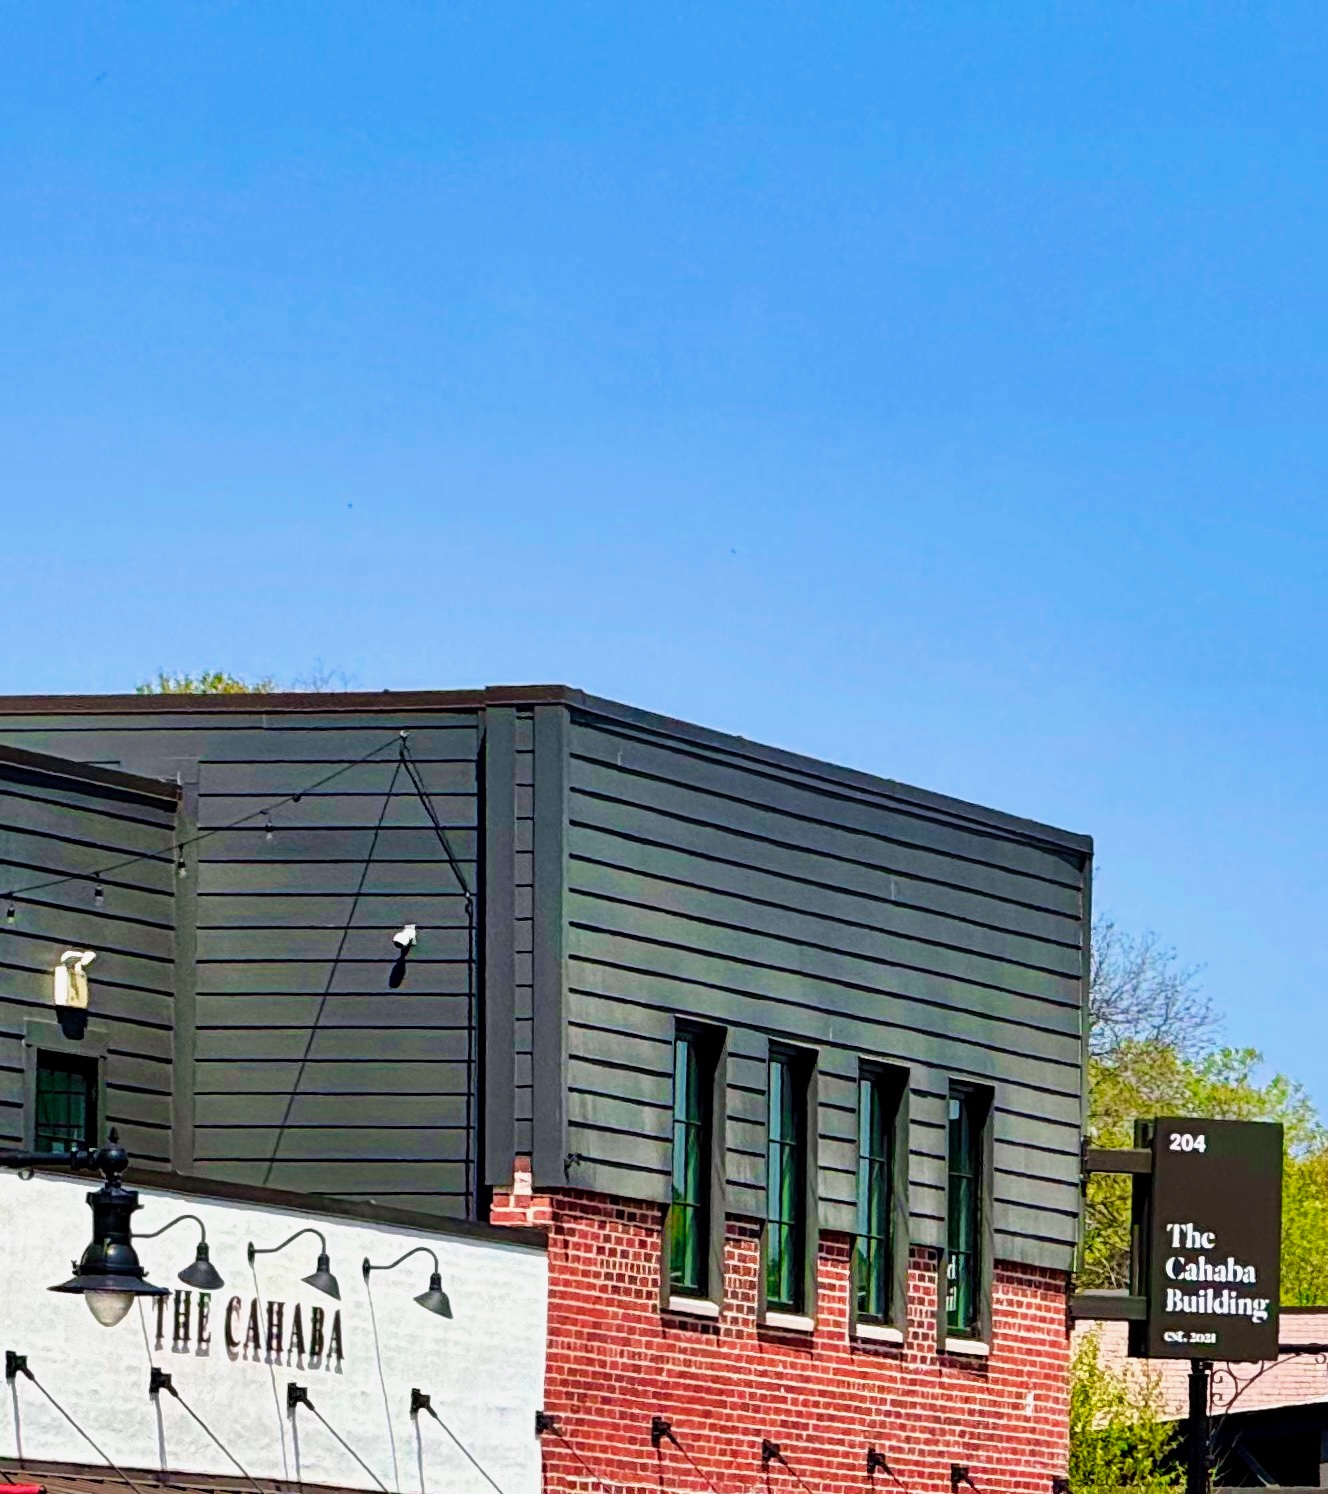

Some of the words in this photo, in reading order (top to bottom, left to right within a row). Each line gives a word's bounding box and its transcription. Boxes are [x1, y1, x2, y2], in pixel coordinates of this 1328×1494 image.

[1169, 1133, 1206, 1153] 204
[1166, 1223, 1216, 1249] The
[1165, 1256, 1257, 1284] Cahaba
[1165, 1288, 1270, 1323] Building
[152, 1289, 212, 1343] THE
[225, 1296, 344, 1360] CAHABA
